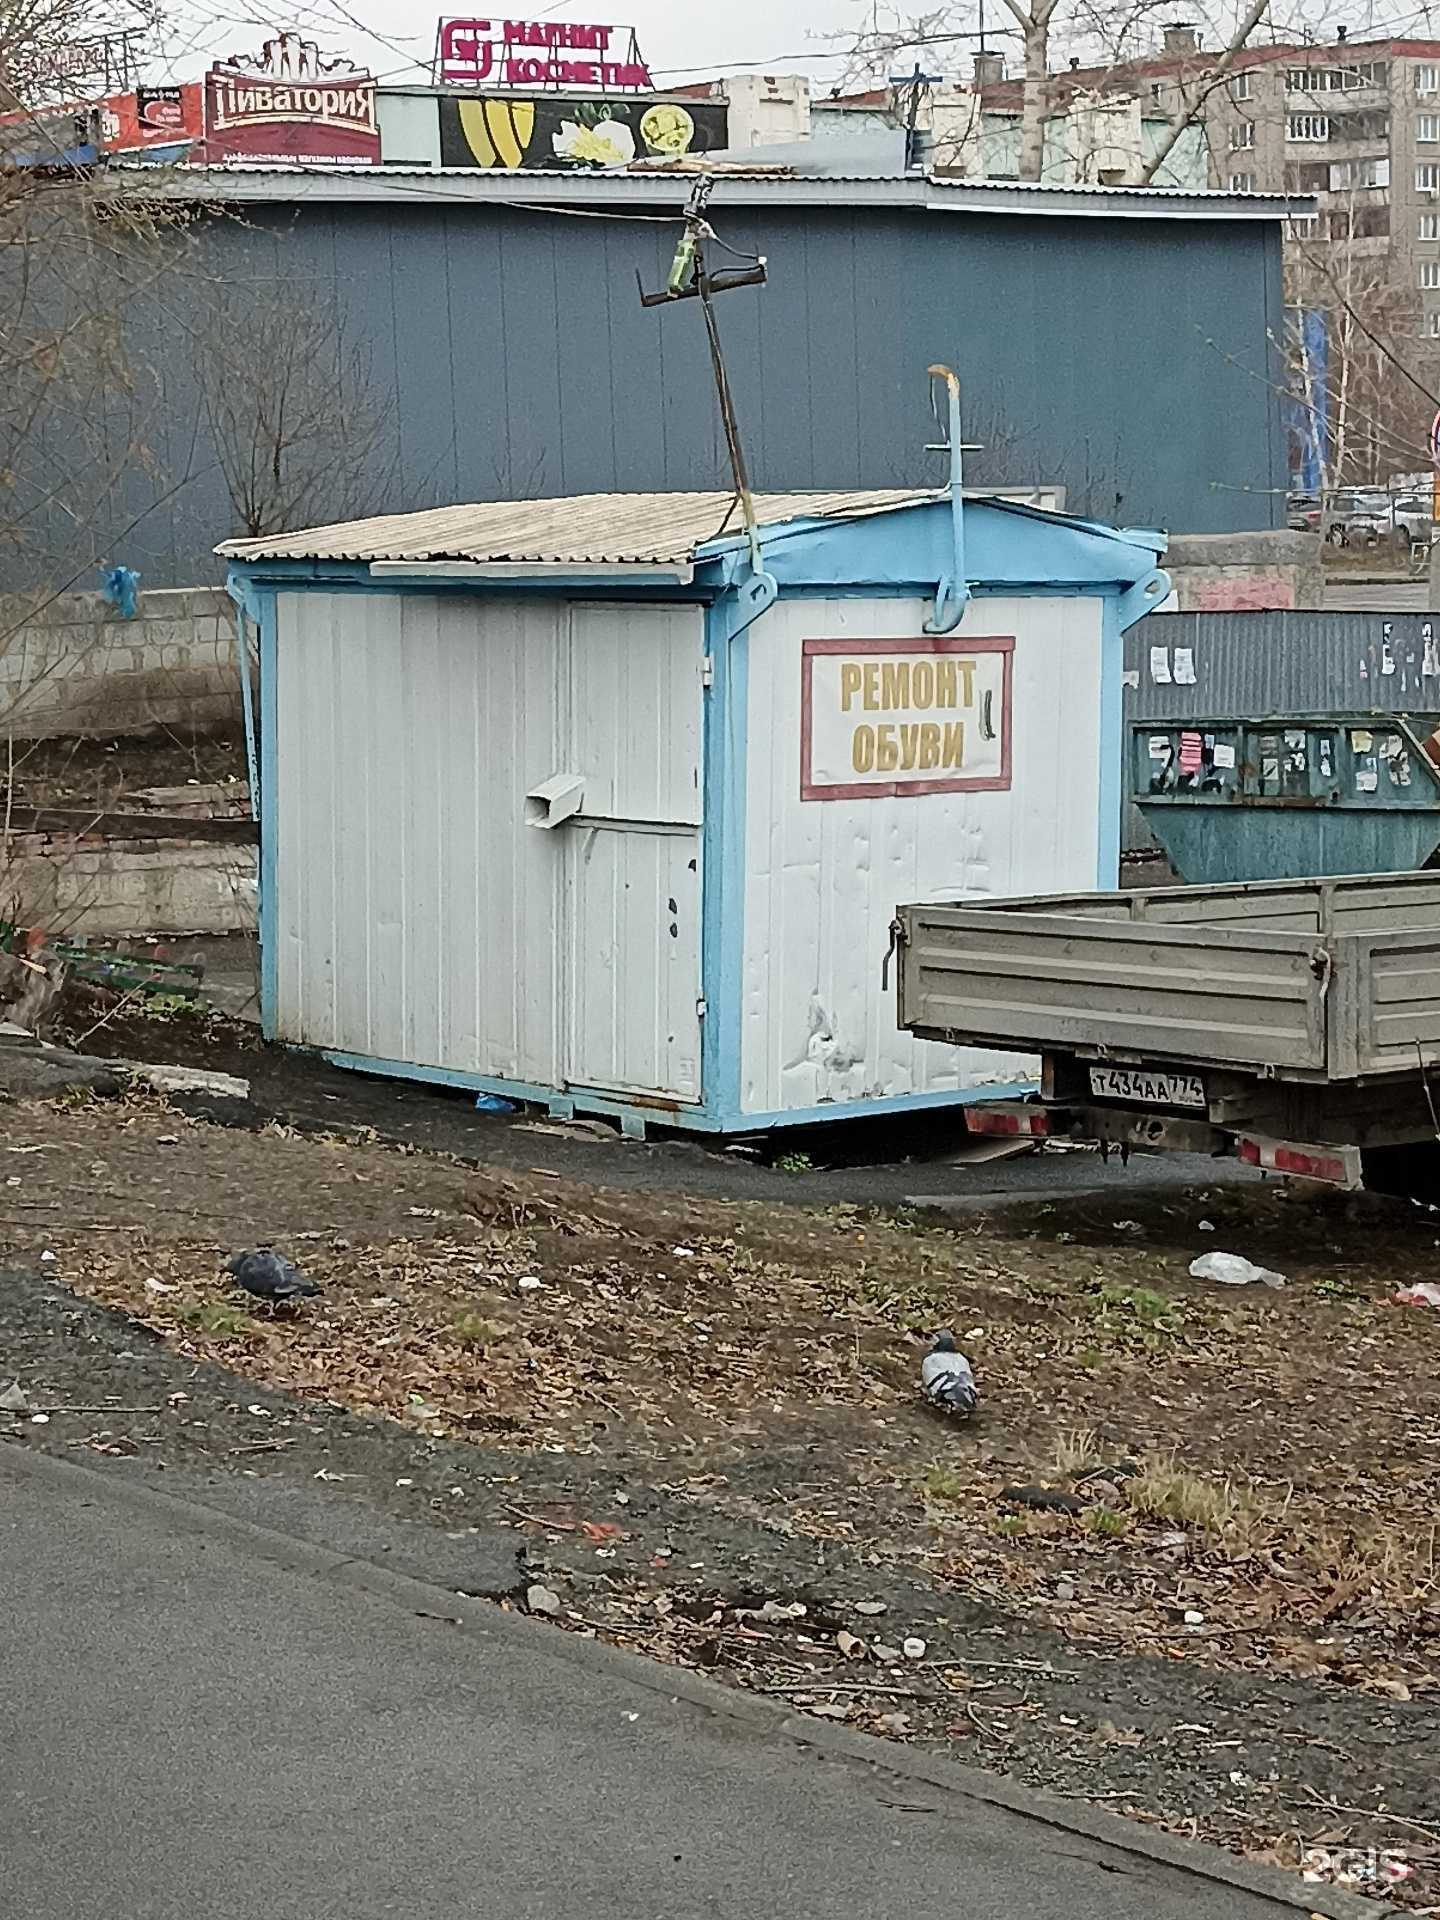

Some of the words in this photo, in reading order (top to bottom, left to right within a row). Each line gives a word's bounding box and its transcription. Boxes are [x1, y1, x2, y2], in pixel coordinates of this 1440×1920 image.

[504, 20, 613, 49] МАГНИТ
[841, 660, 976, 712] РЕМОНТ
[852, 721, 965, 774] ОБУВИ
